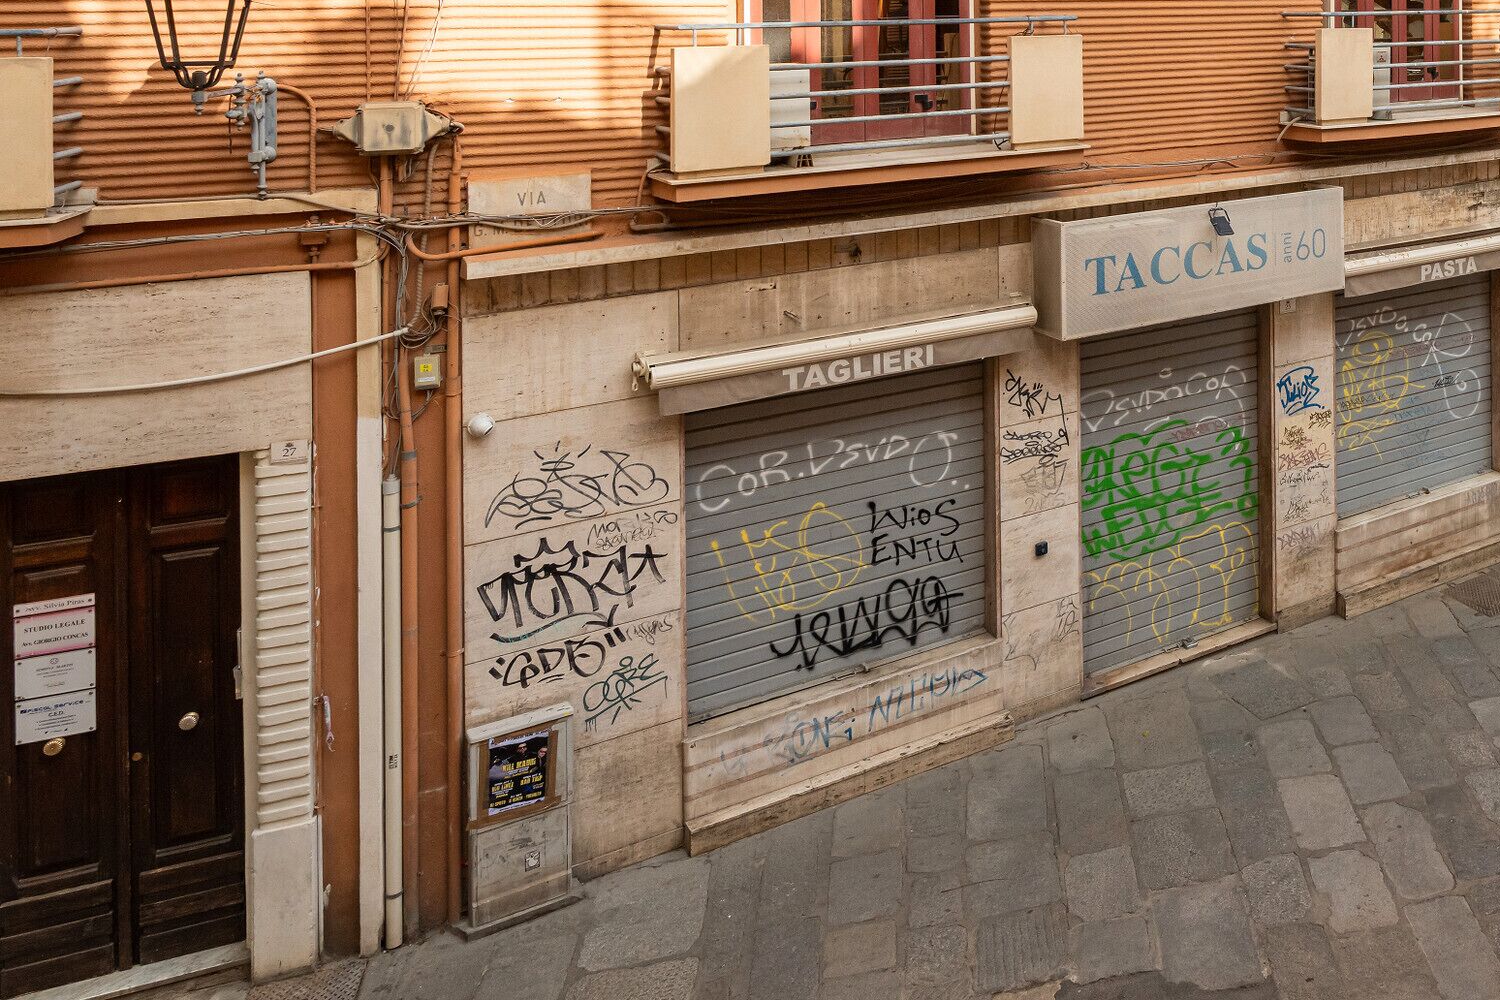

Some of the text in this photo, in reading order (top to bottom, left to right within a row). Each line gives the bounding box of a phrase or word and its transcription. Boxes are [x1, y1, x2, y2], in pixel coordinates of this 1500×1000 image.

[517, 191, 546, 206] VIA
[1085, 228, 1326, 296] TACCAS anni 60
[1421, 257, 1478, 282] PASTA
[782, 344, 934, 392] TAGLIERI
[282, 447, 297, 457] 27
[23, 618, 86, 634] STUDIO LEGALE
[33, 635, 62, 646] GIORGIO
[62, 631, 89, 642] CONCAS
